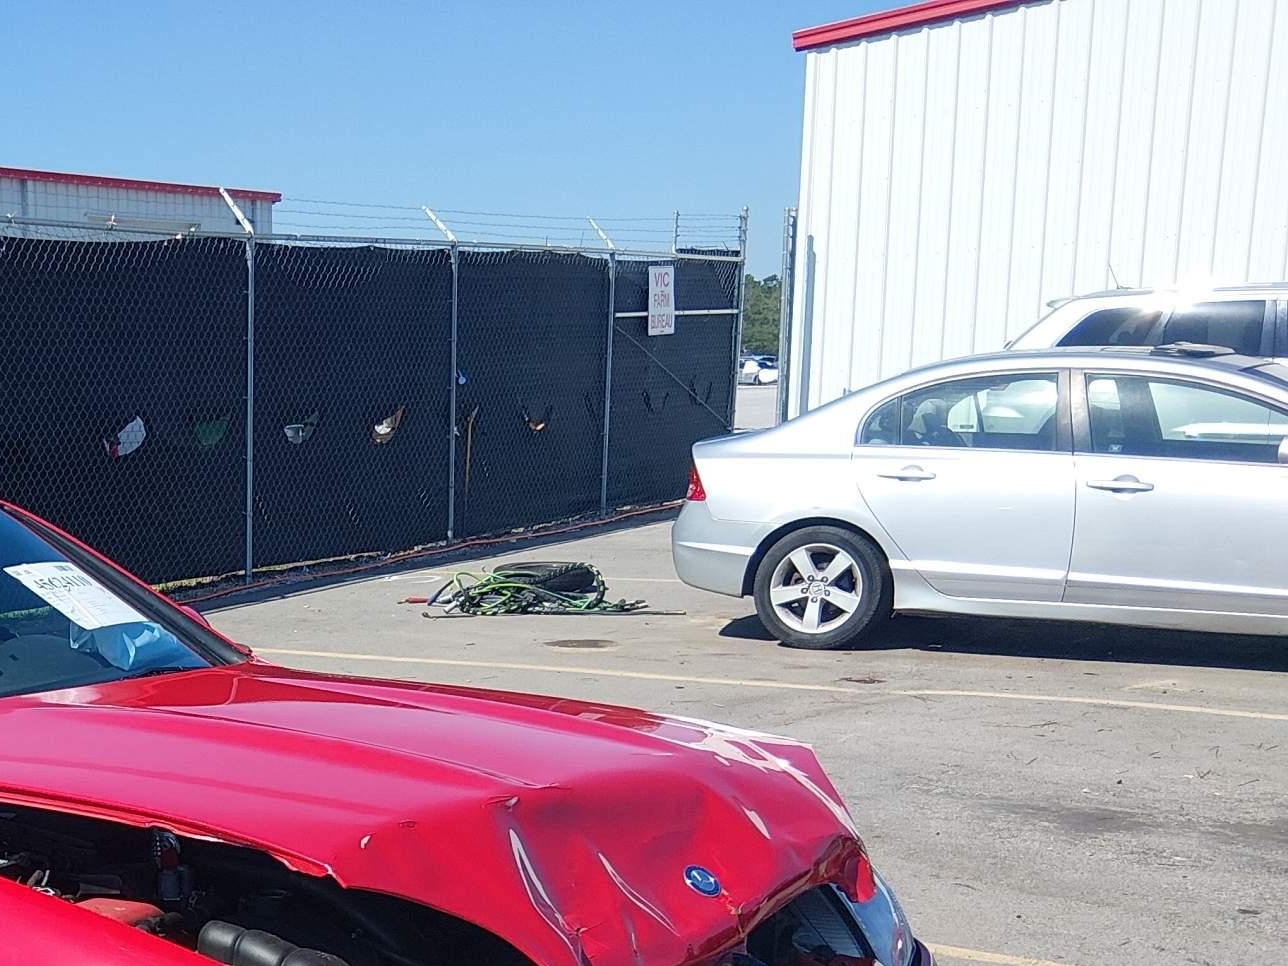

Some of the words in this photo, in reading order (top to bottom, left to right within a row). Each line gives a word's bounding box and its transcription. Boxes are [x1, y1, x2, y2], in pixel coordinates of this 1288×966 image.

[654, 271, 670, 288] VIC
[653, 293, 670, 308] FARM
[651, 314, 672, 329] BUREAU
